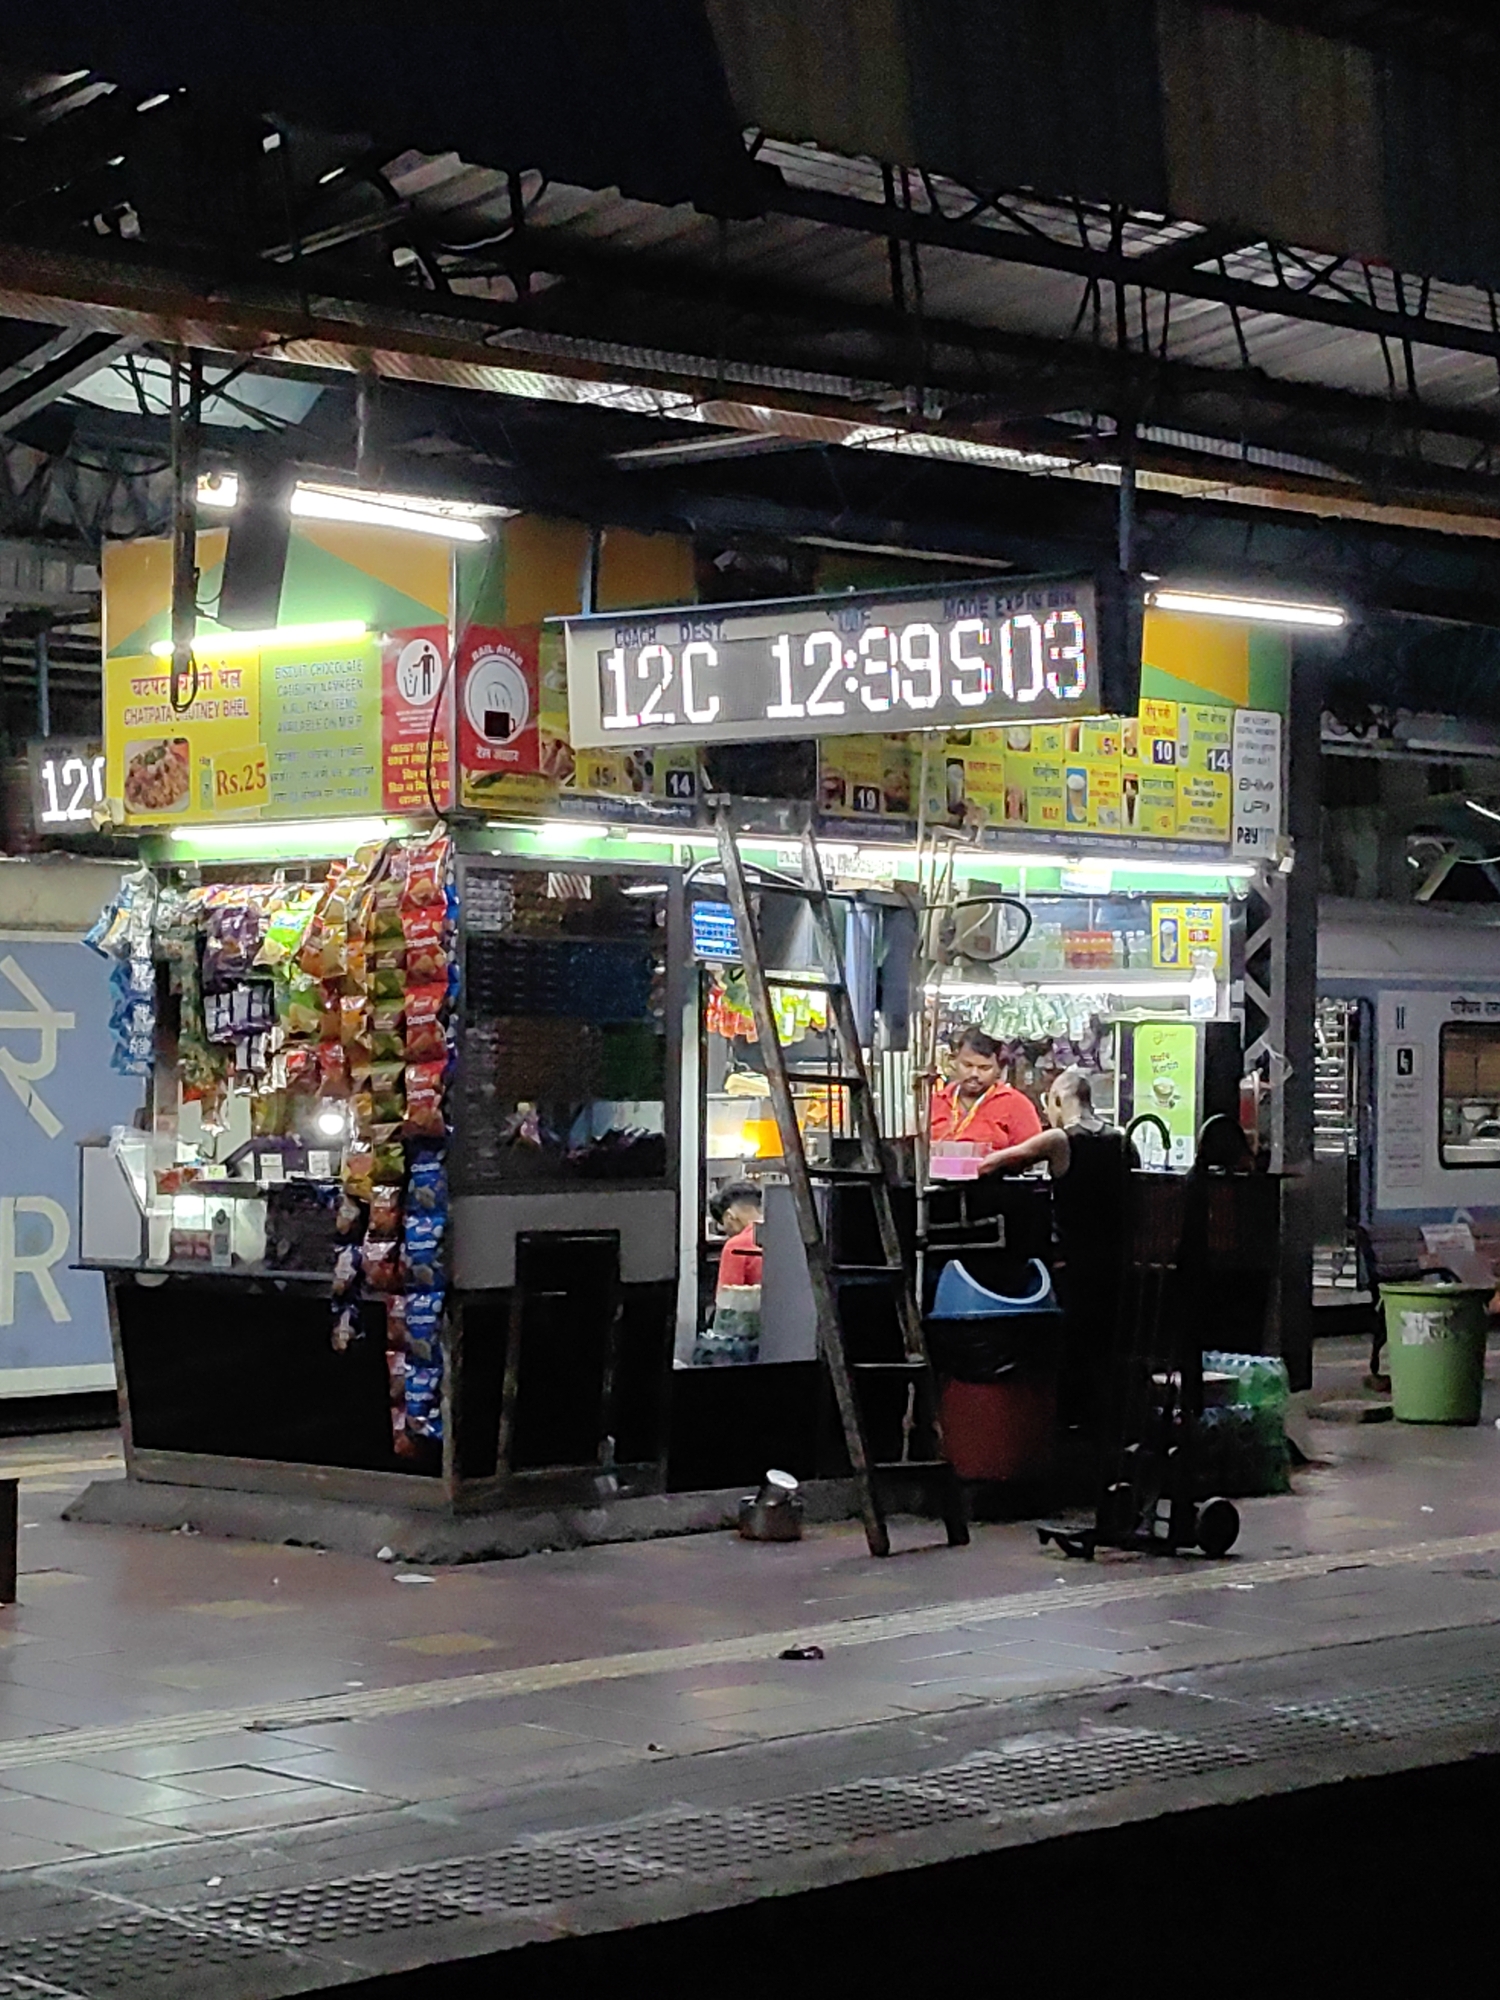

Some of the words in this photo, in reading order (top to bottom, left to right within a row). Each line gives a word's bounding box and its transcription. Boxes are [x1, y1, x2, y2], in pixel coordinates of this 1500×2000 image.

[1155, 740, 1173, 761] 10
[1207, 750, 1231, 772] 14
[216, 761, 267, 797] Rs.25
[670, 773, 691, 796] 14
